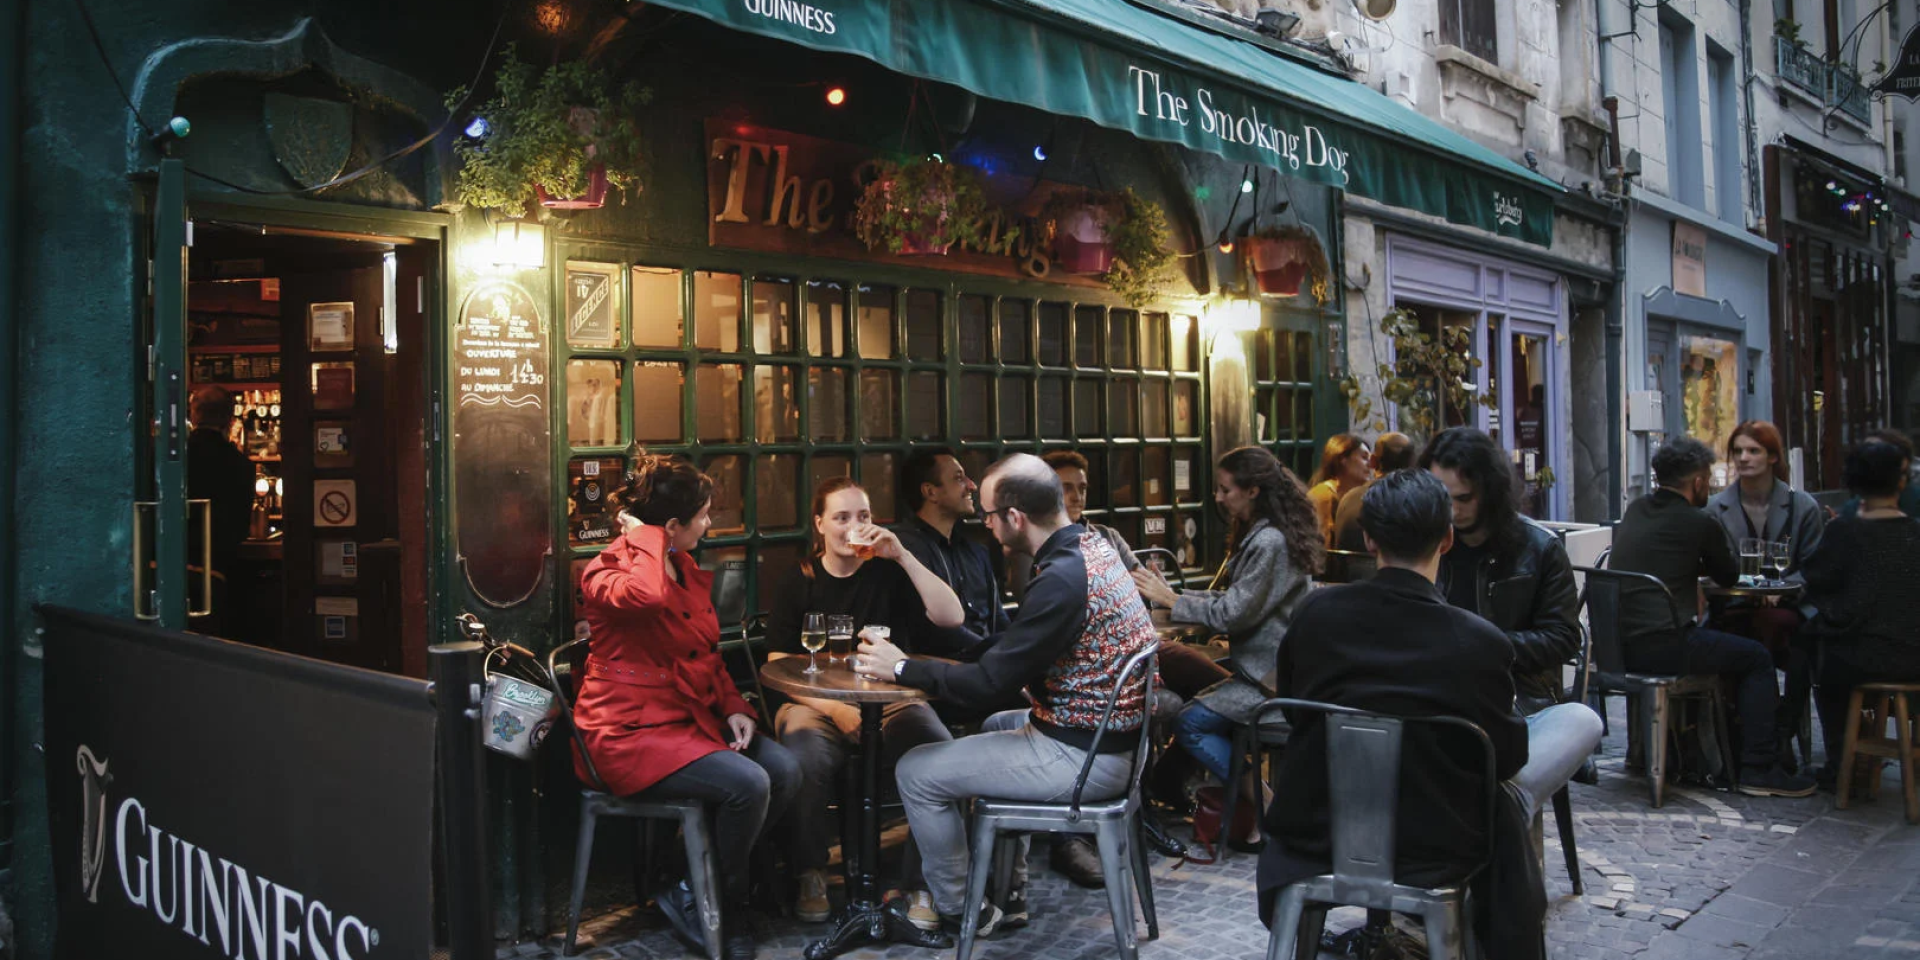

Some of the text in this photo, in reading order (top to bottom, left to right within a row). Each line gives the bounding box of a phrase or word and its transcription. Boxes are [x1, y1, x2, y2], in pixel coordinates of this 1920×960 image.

[745, 0, 836, 34] GUINNESS
[1128, 65, 1349, 185] The Smoking Dog
[713, 138, 835, 233] The
[1493, 191, 1522, 225] arlsberg
[466, 349, 518, 359] OUVERTURE
[460, 367, 473, 377] DU
[474, 367, 501, 377] LUNDI
[460, 382, 515, 393] AU DIMANCHE
[579, 529, 609, 540] GUINNESS
[504, 683, 546, 706] Brooklyn
